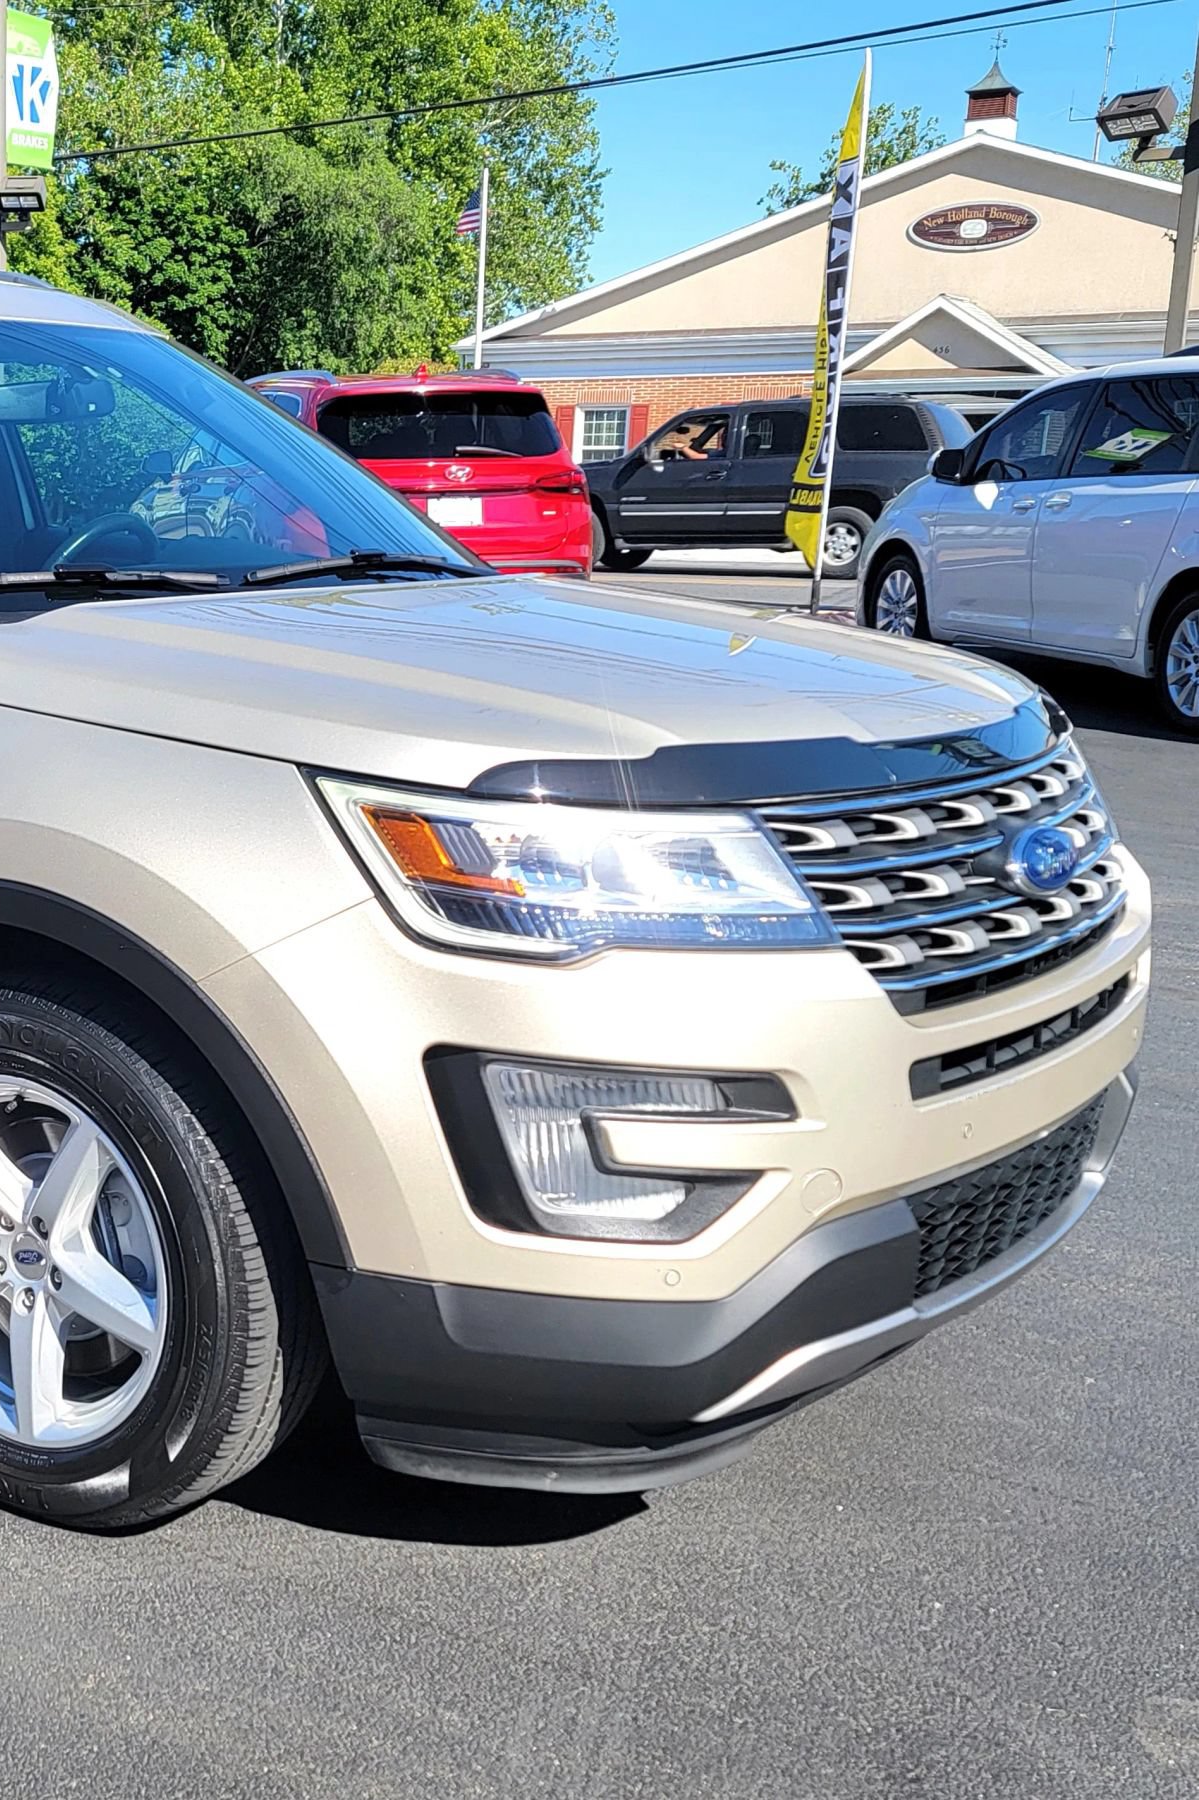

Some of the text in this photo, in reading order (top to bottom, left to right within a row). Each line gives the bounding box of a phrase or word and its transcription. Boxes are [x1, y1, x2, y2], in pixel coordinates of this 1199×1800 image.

[11, 132, 49, 151] BRAKES
[922, 206, 1029, 229] New Holland Borough
[18, 1251, 38, 1264] Ford
